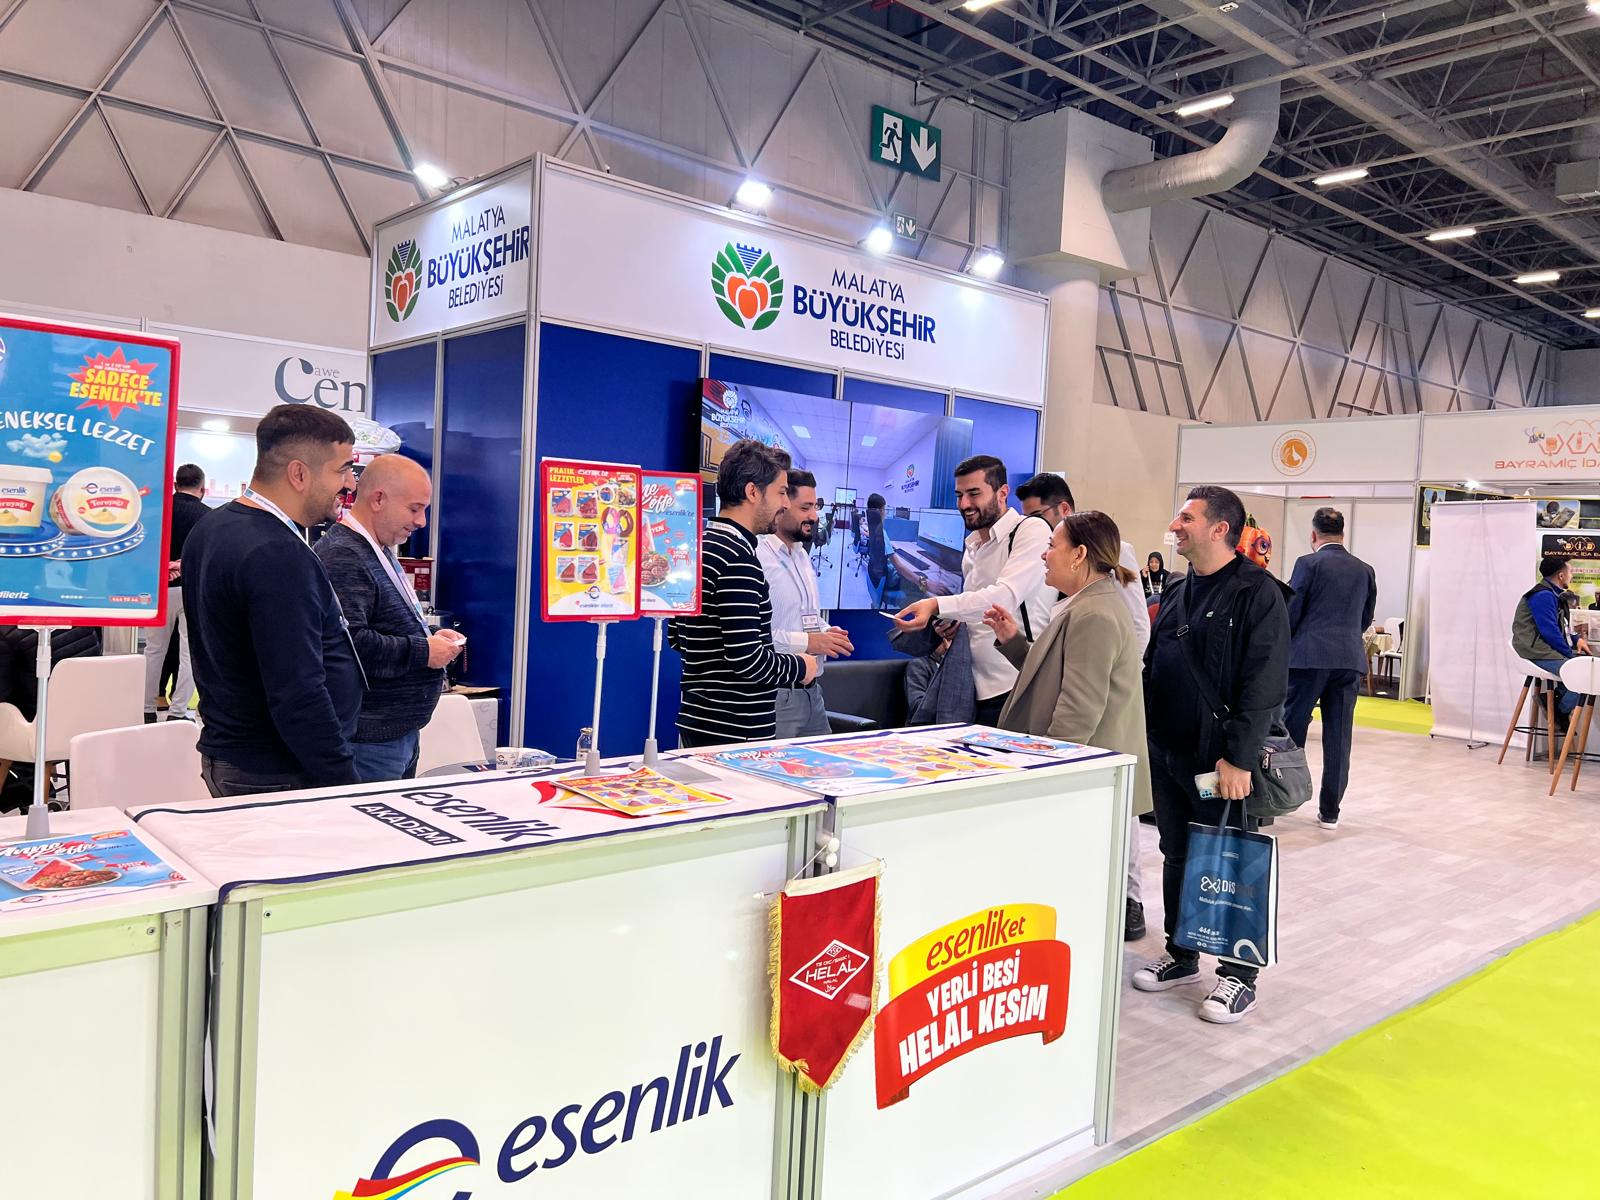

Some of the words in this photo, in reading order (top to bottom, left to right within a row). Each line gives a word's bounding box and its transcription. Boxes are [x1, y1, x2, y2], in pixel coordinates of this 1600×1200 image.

[452, 205, 506, 243] MALATYA
[448, 274, 504, 309] BELEDİYESİ
[831, 268, 905, 304] MALATYA
[793, 285, 936, 344] BÜYÜKŞEHİR
[830, 329, 905, 361] BELEDİYESİ
[69, 382, 163, 407] ESENLİK'TE
[84, 368, 150, 390] SADECE
[82, 418, 156, 456] LEZZET
[550, 475, 585, 484] LEZZETLER
[1495, 458, 1577, 470] BAYRAMİÇ
[1, 486, 28, 495] esenlik
[357, 805, 460, 845] AKADEMİ
[401, 791, 561, 842] esenlik
[805, 959, 857, 983] HELAL
[926, 960, 978, 1018] YERLİ
[982, 948, 1021, 993] BESİ
[899, 1005, 973, 1077] HELAL
[978, 984, 1049, 1035] KESİM
[497, 1034, 742, 1184] esenlik
